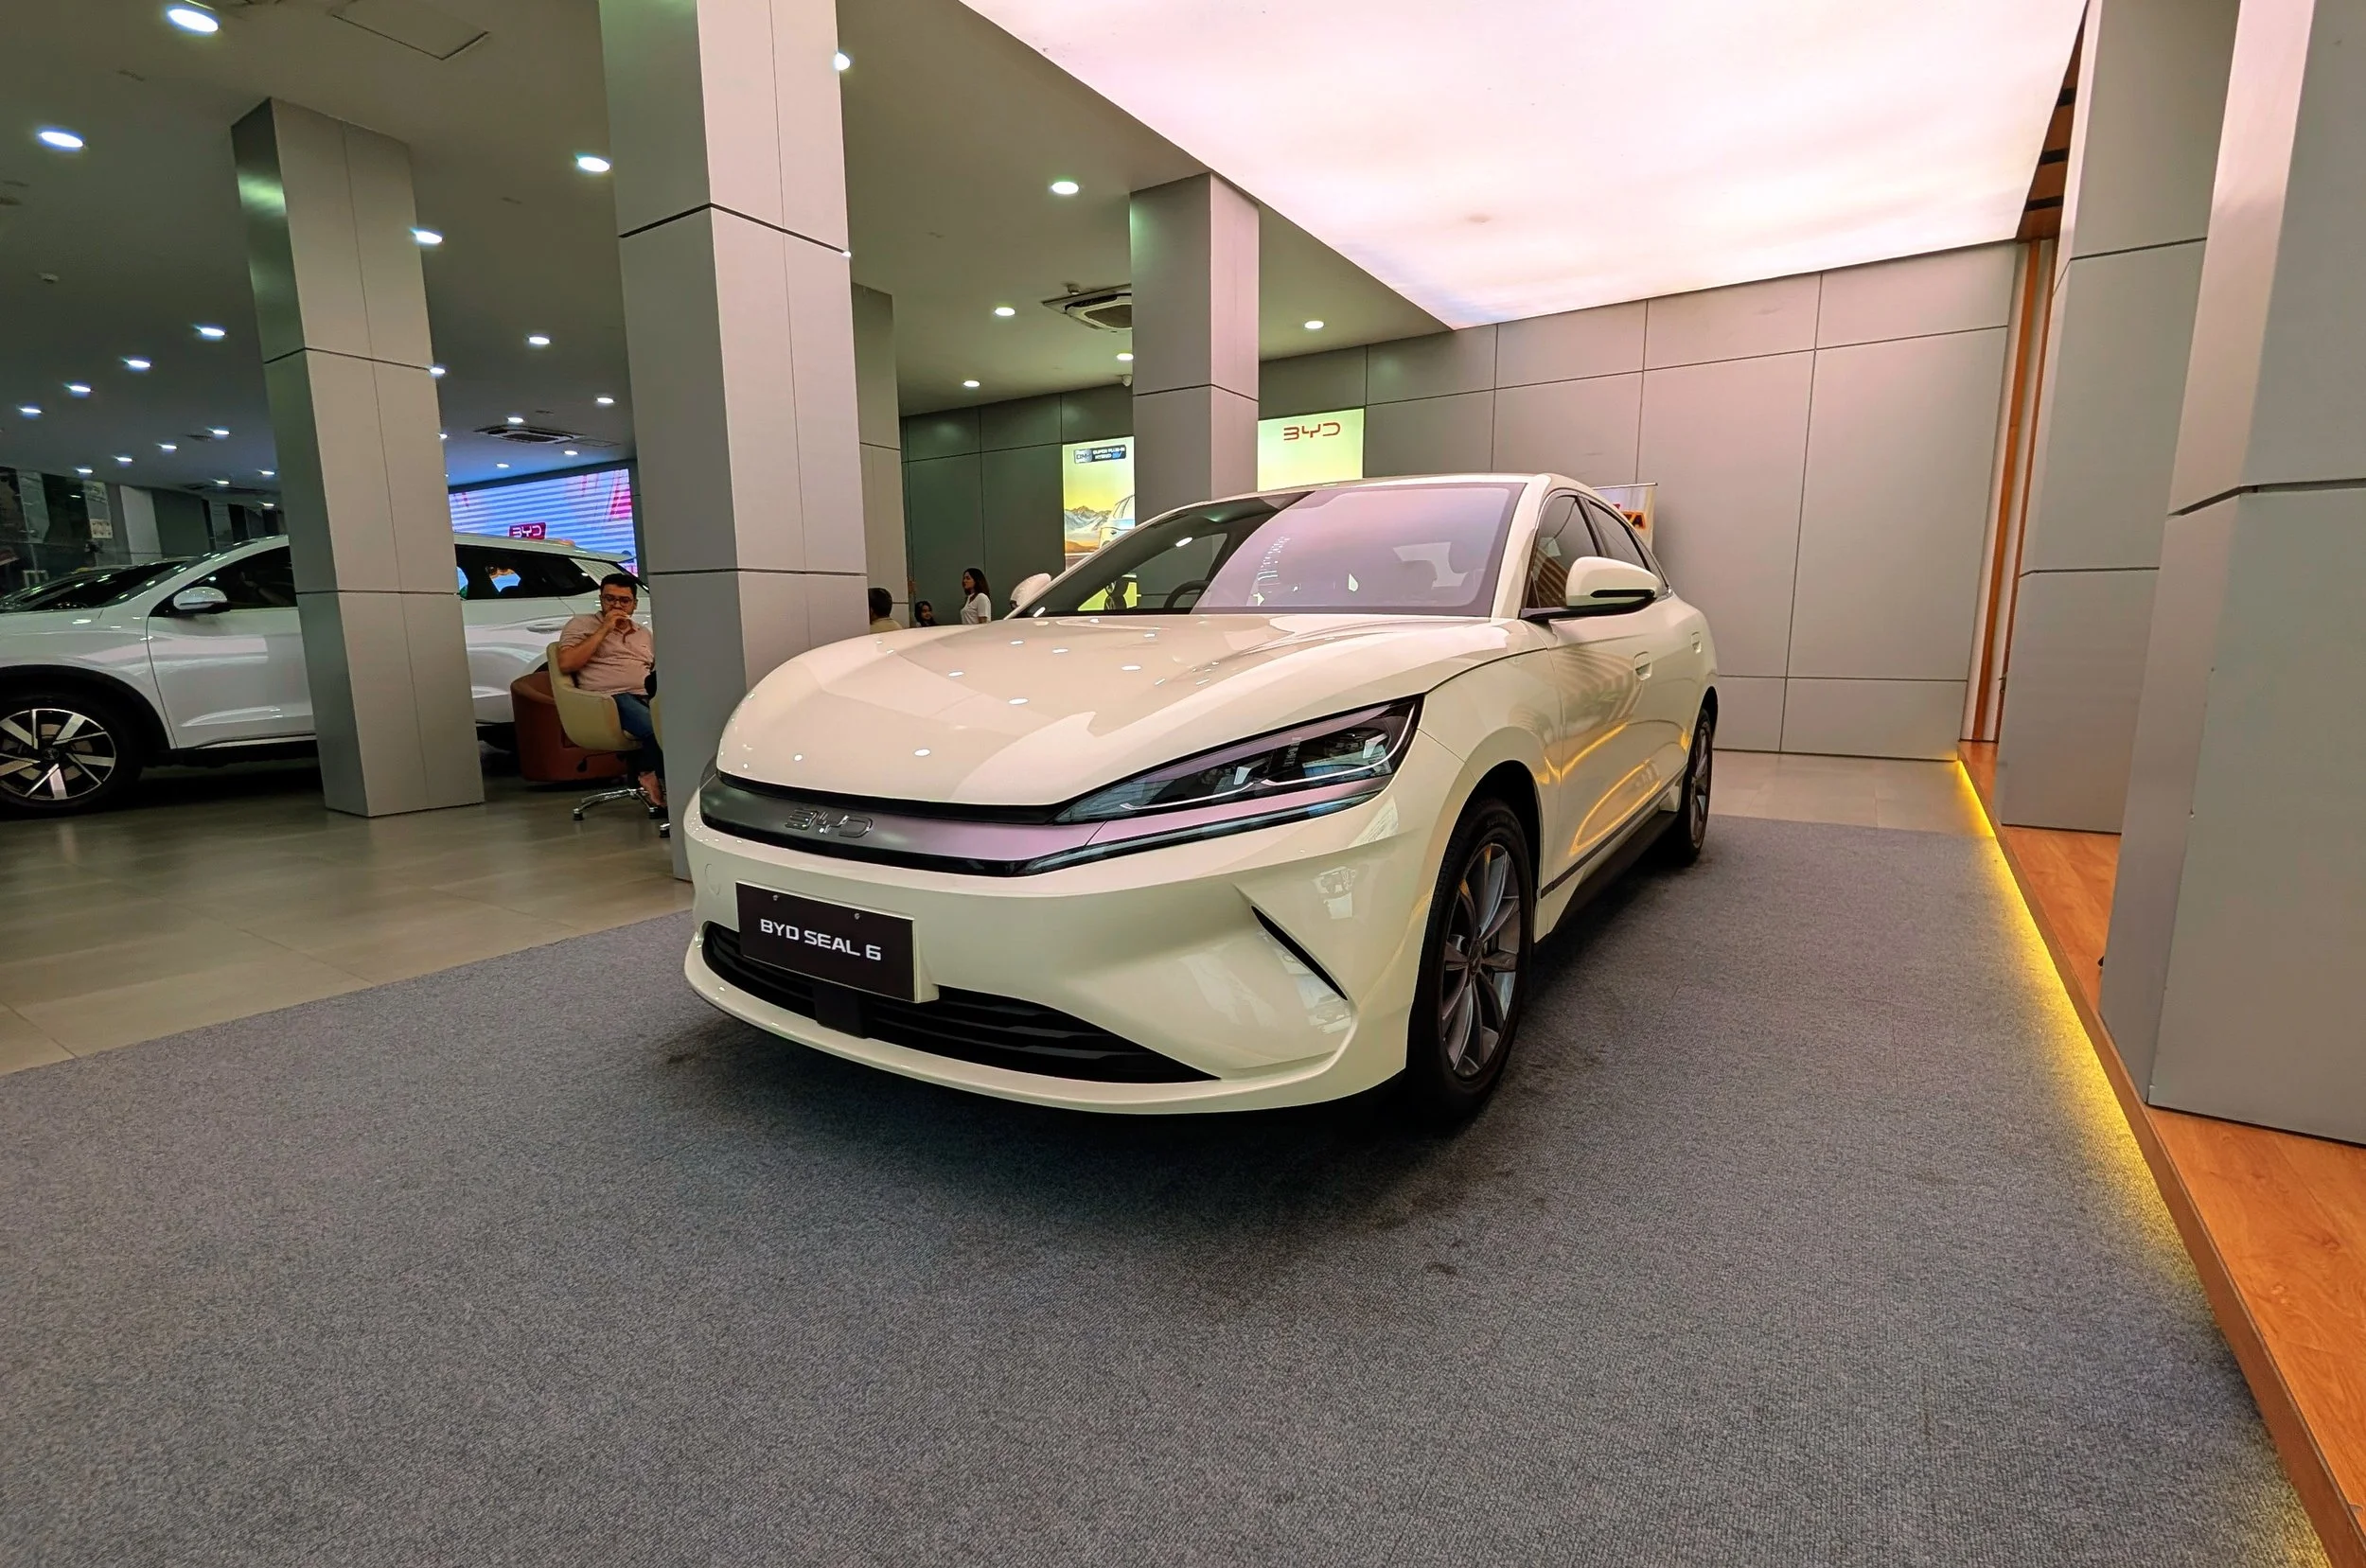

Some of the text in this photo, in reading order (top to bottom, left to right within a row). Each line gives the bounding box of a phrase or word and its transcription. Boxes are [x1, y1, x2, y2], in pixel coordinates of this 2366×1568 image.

[1283, 422, 1341, 441] BYD
[512, 524, 542, 538] BYD
[785, 807, 874, 838] BYD
[760, 918, 882, 961] BYD SEAL 6
